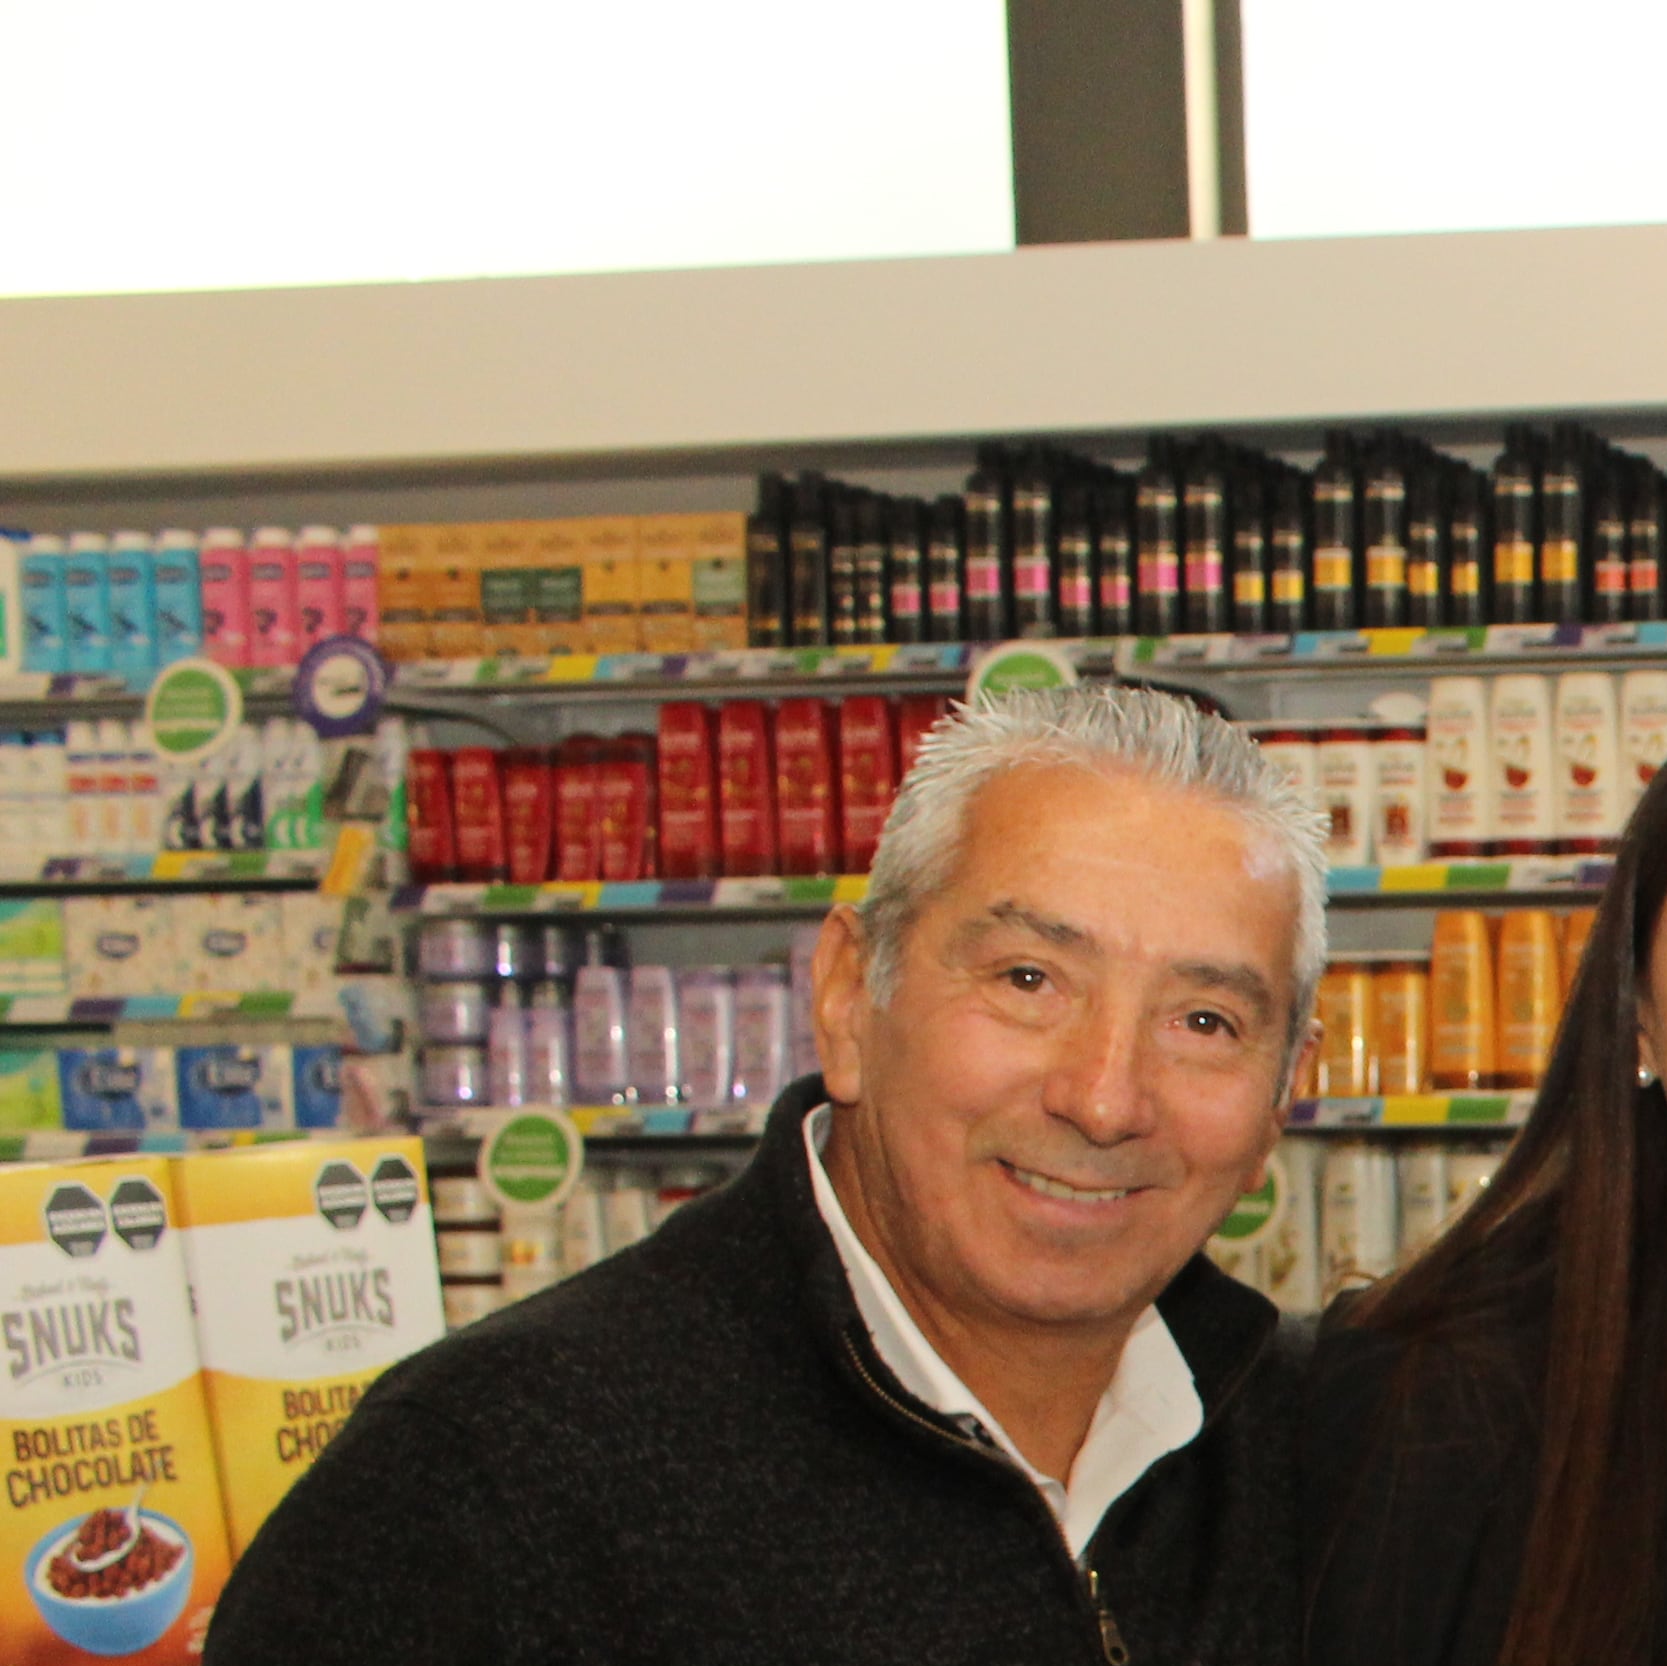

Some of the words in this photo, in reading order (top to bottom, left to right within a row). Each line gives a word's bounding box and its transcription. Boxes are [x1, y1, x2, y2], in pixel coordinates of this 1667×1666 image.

[275, 1267, 395, 1343] SNUKS
[2, 1297, 142, 1380] SNUKS
[62, 1370, 104, 1389] KIDS
[13, 1418, 122, 1462] BOLITAS
[127, 1409, 159, 1443] DE
[6, 1444, 178, 1509] CHOCOLATE
